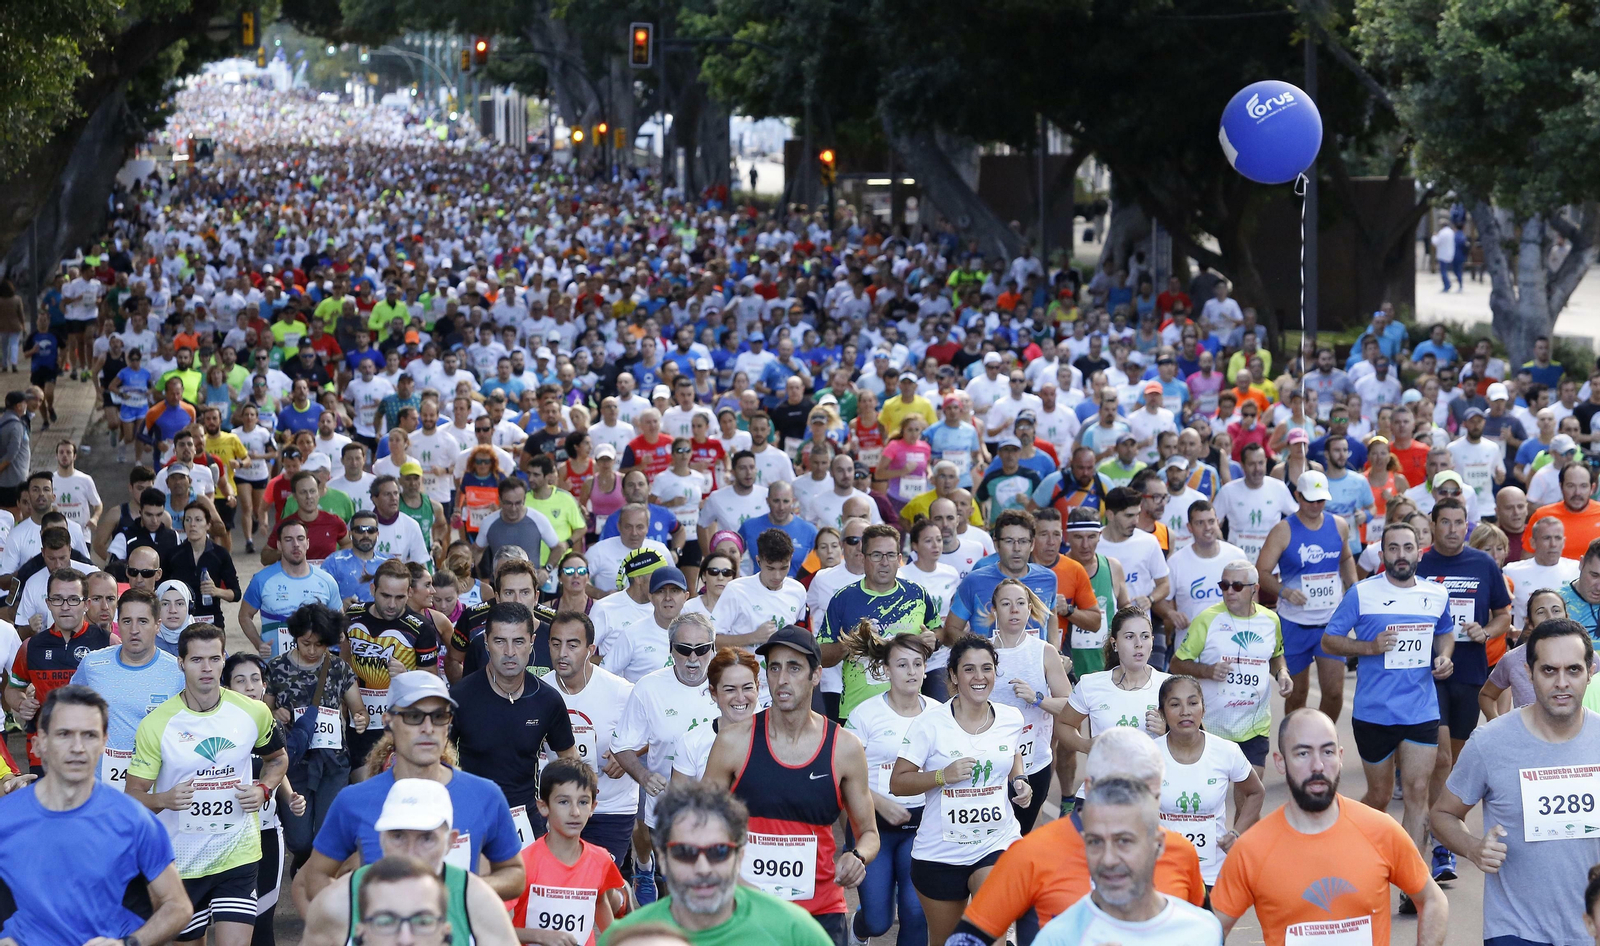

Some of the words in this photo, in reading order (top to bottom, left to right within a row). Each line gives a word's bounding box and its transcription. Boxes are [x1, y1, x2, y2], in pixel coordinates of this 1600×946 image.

[1246, 91, 1295, 118] Forus
[1190, 576, 1225, 600] Foru
[1309, 586, 1333, 598] 9906
[1398, 639, 1421, 652] 270
[1227, 671, 1259, 686] 3399
[1019, 741, 1033, 756] 27
[110, 767, 127, 782] 24
[196, 765, 235, 778] Unicaja
[1522, 770, 1537, 780] 41
[1538, 768, 1573, 776] CARRERA
[190, 799, 233, 816] 3828
[1538, 793, 1595, 816] 3289
[947, 806, 1001, 824] 18266
[1185, 833, 1205, 846] 23
[753, 858, 804, 878] 9960
[532, 886, 544, 898] 41
[537, 911, 585, 932] 9961
[1289, 925, 1303, 936] 41
[1304, 923, 1340, 931] CARRERA
[1341, 918, 1370, 929] URBANA
